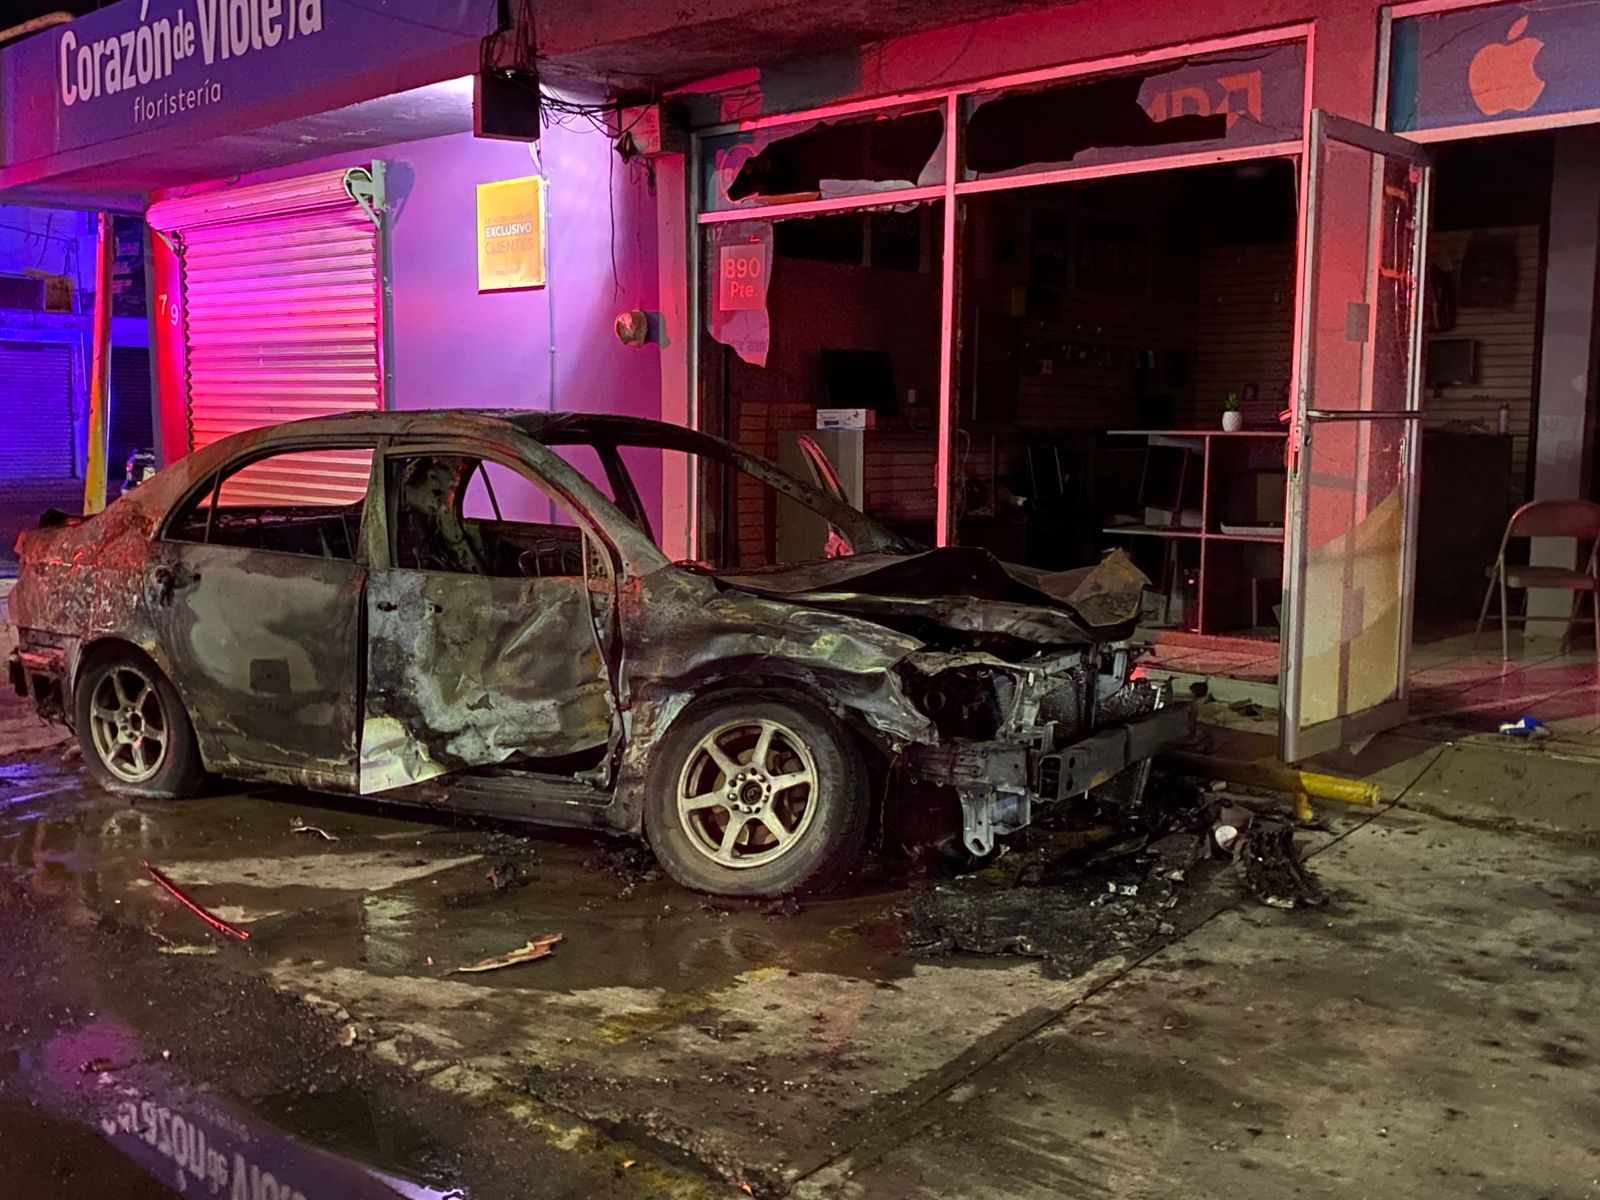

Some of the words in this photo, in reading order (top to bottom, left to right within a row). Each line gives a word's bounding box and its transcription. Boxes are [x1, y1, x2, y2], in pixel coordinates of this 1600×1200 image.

[60, 0, 173, 107] Corazón
[173, 8, 195, 61] de
[133, 78, 222, 123] floristería
[485, 222, 532, 238] EXCLUSIVO
[485, 238, 533, 255] CLIENTES
[725, 257, 761, 279] 890
